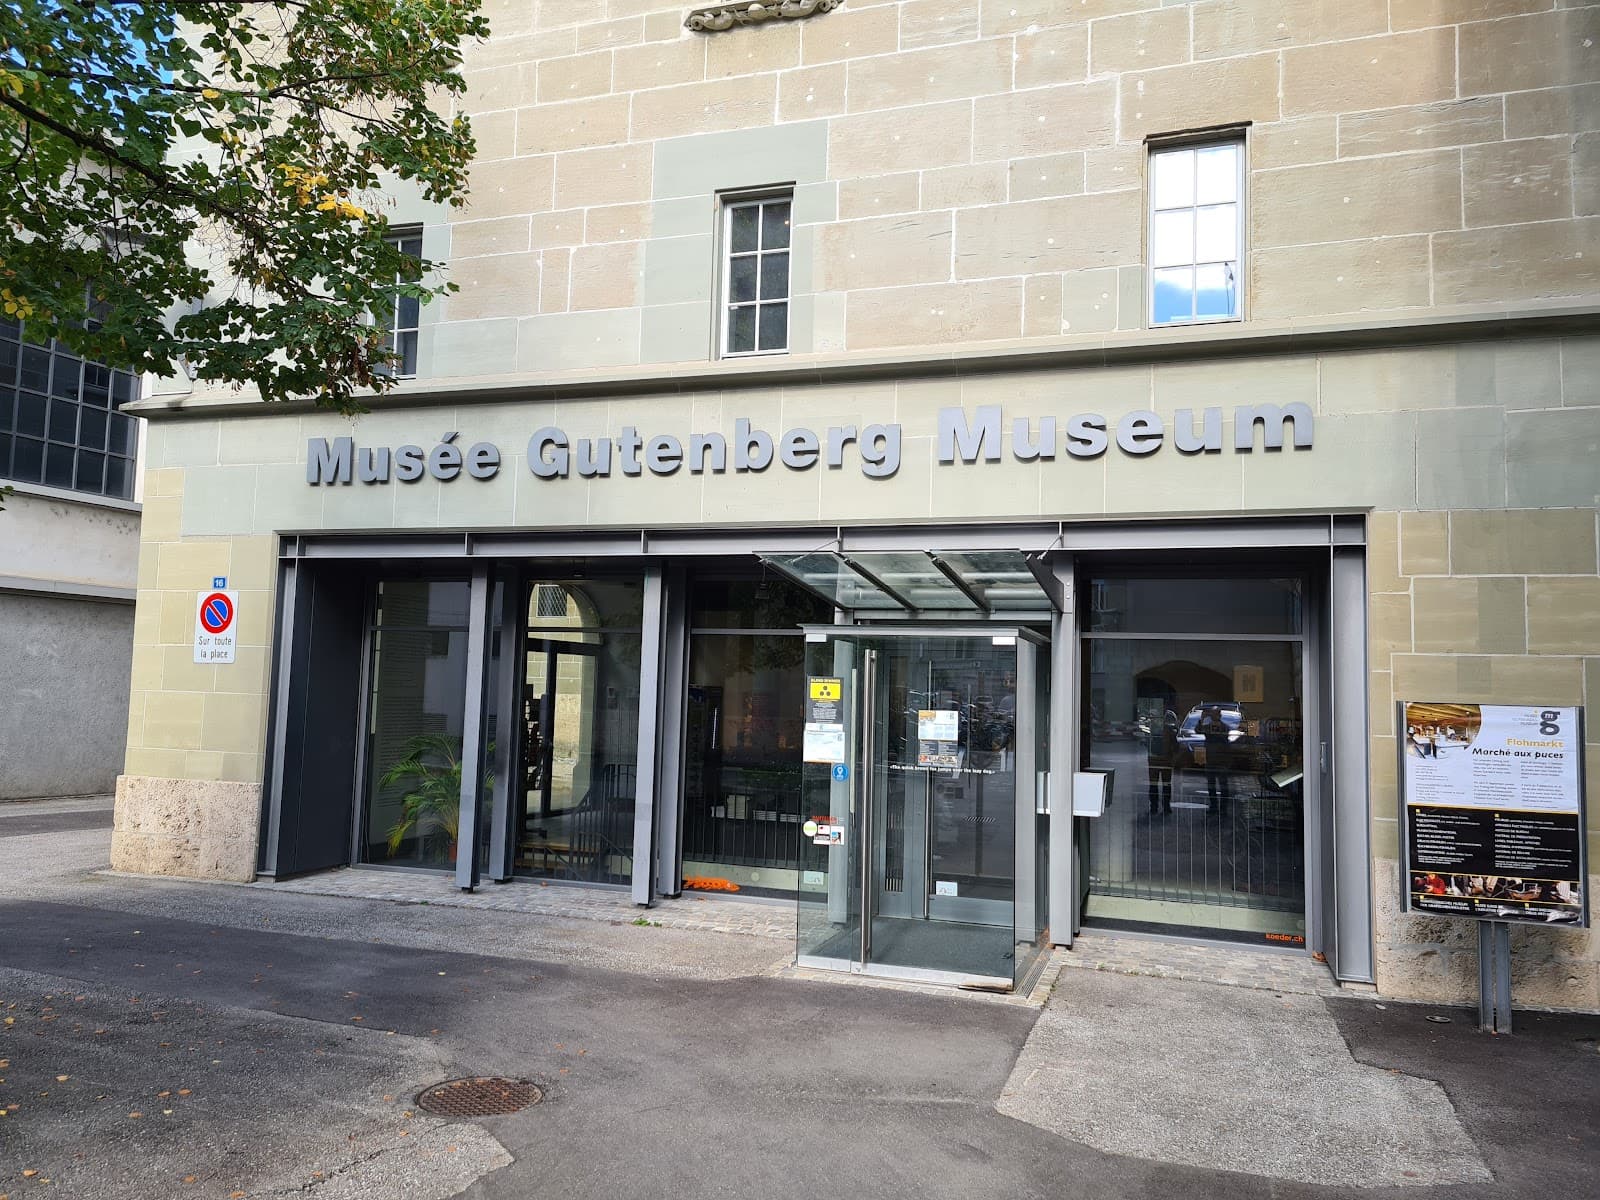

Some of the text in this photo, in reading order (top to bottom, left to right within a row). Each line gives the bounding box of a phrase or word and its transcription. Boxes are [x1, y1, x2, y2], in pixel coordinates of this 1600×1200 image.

[306, 401, 1314, 485] Musée Gutenberg Museum
[198, 636, 232, 646] Sur toute
[200, 649, 228, 661] la place
[1506, 738, 1565, 748] Flohmarkt
[1472, 747, 1511, 757] Marché
[1534, 751, 1564, 760] puces
